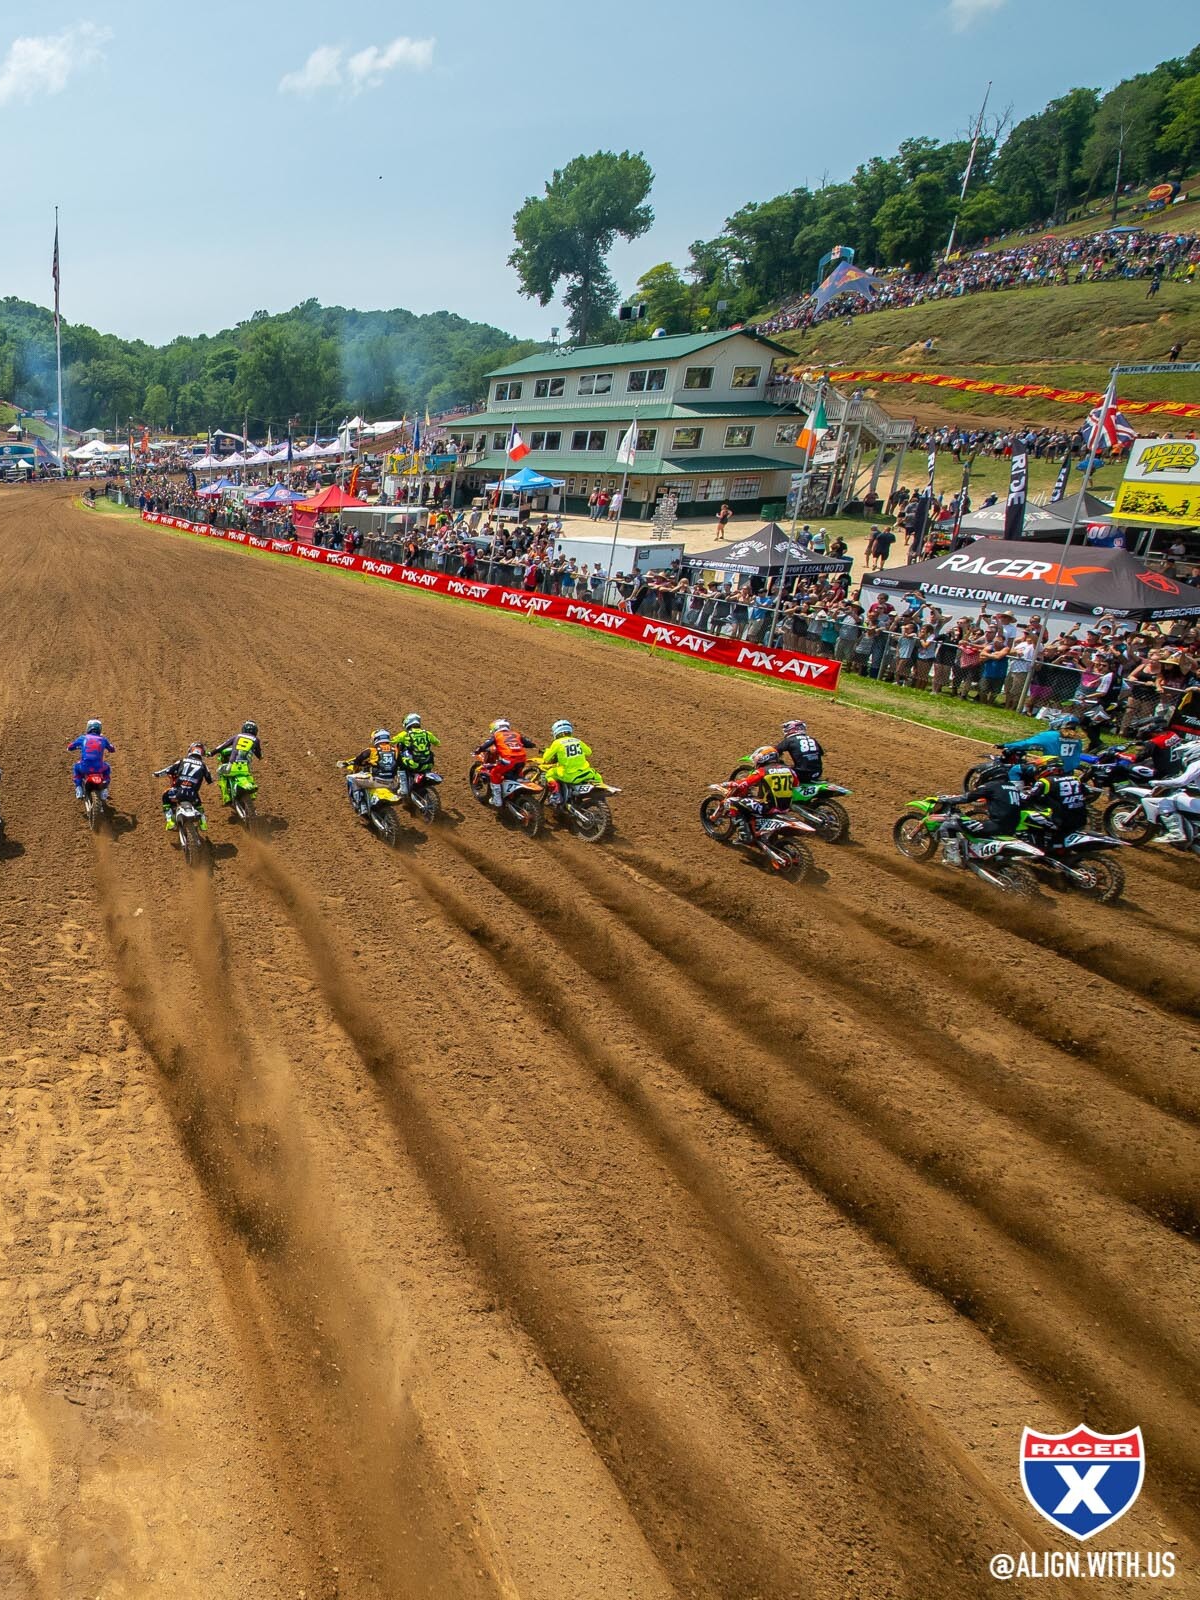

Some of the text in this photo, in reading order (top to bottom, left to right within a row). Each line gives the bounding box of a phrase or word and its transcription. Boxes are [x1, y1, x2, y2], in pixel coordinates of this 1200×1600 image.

[1140, 443, 1196, 466] MOTO
[1145, 454, 1199, 475] TEES
[1007, 453, 1026, 506] RIDE
[824, 564, 844, 572] MOTO
[920, 582, 1068, 611] RACERXONLINE.COM
[566, 604, 592, 622] MX
[593, 612, 627, 628] ATV
[642, 624, 675, 644] MX
[676, 634, 716, 653] ATV
[737, 648, 776, 670] MX
[778, 659, 829, 679] ATV
[236, 736, 254, 752] 9
[182, 762, 201, 777] 17
[382, 756, 393, 764] 34
[1059, 781, 1080, 796] 97
